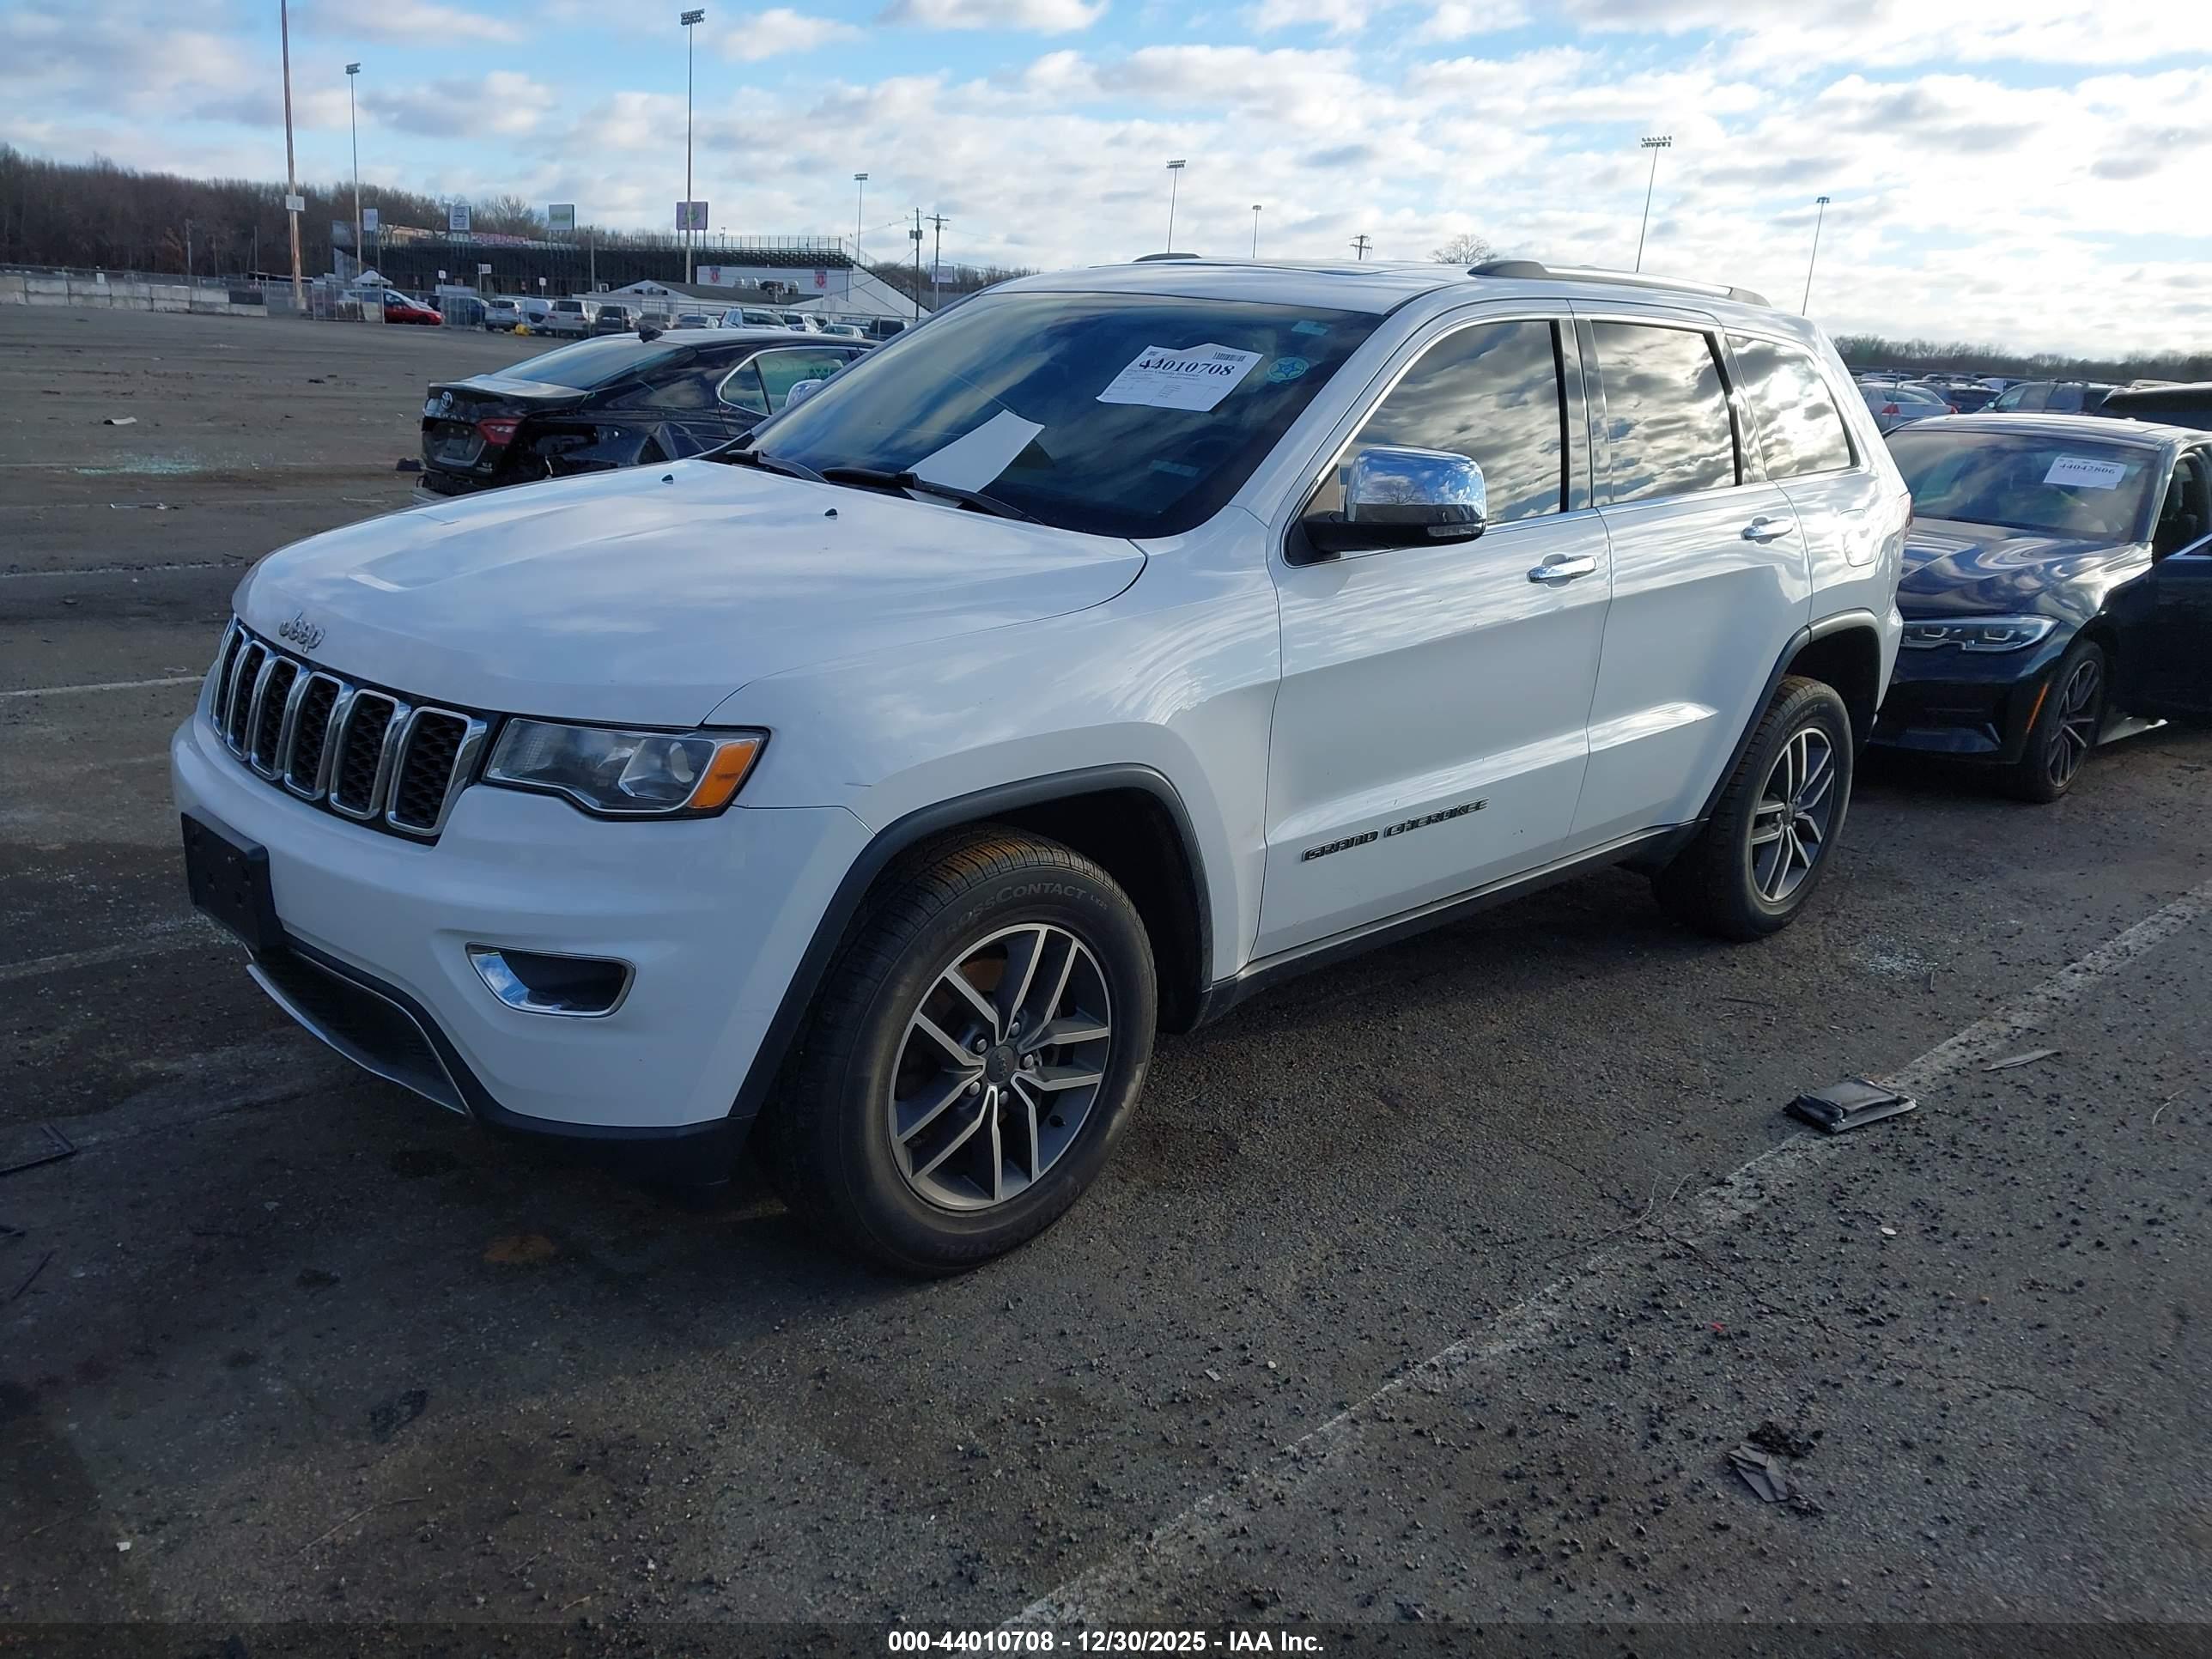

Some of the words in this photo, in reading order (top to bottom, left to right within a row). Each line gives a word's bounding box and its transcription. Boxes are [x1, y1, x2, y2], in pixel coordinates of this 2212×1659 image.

[1139, 357, 1236, 376] 44010708
[279, 611, 325, 653] Jeep
[1301, 829, 1379, 862] GRAND
[1383, 796, 1490, 838] CHEROKEE
